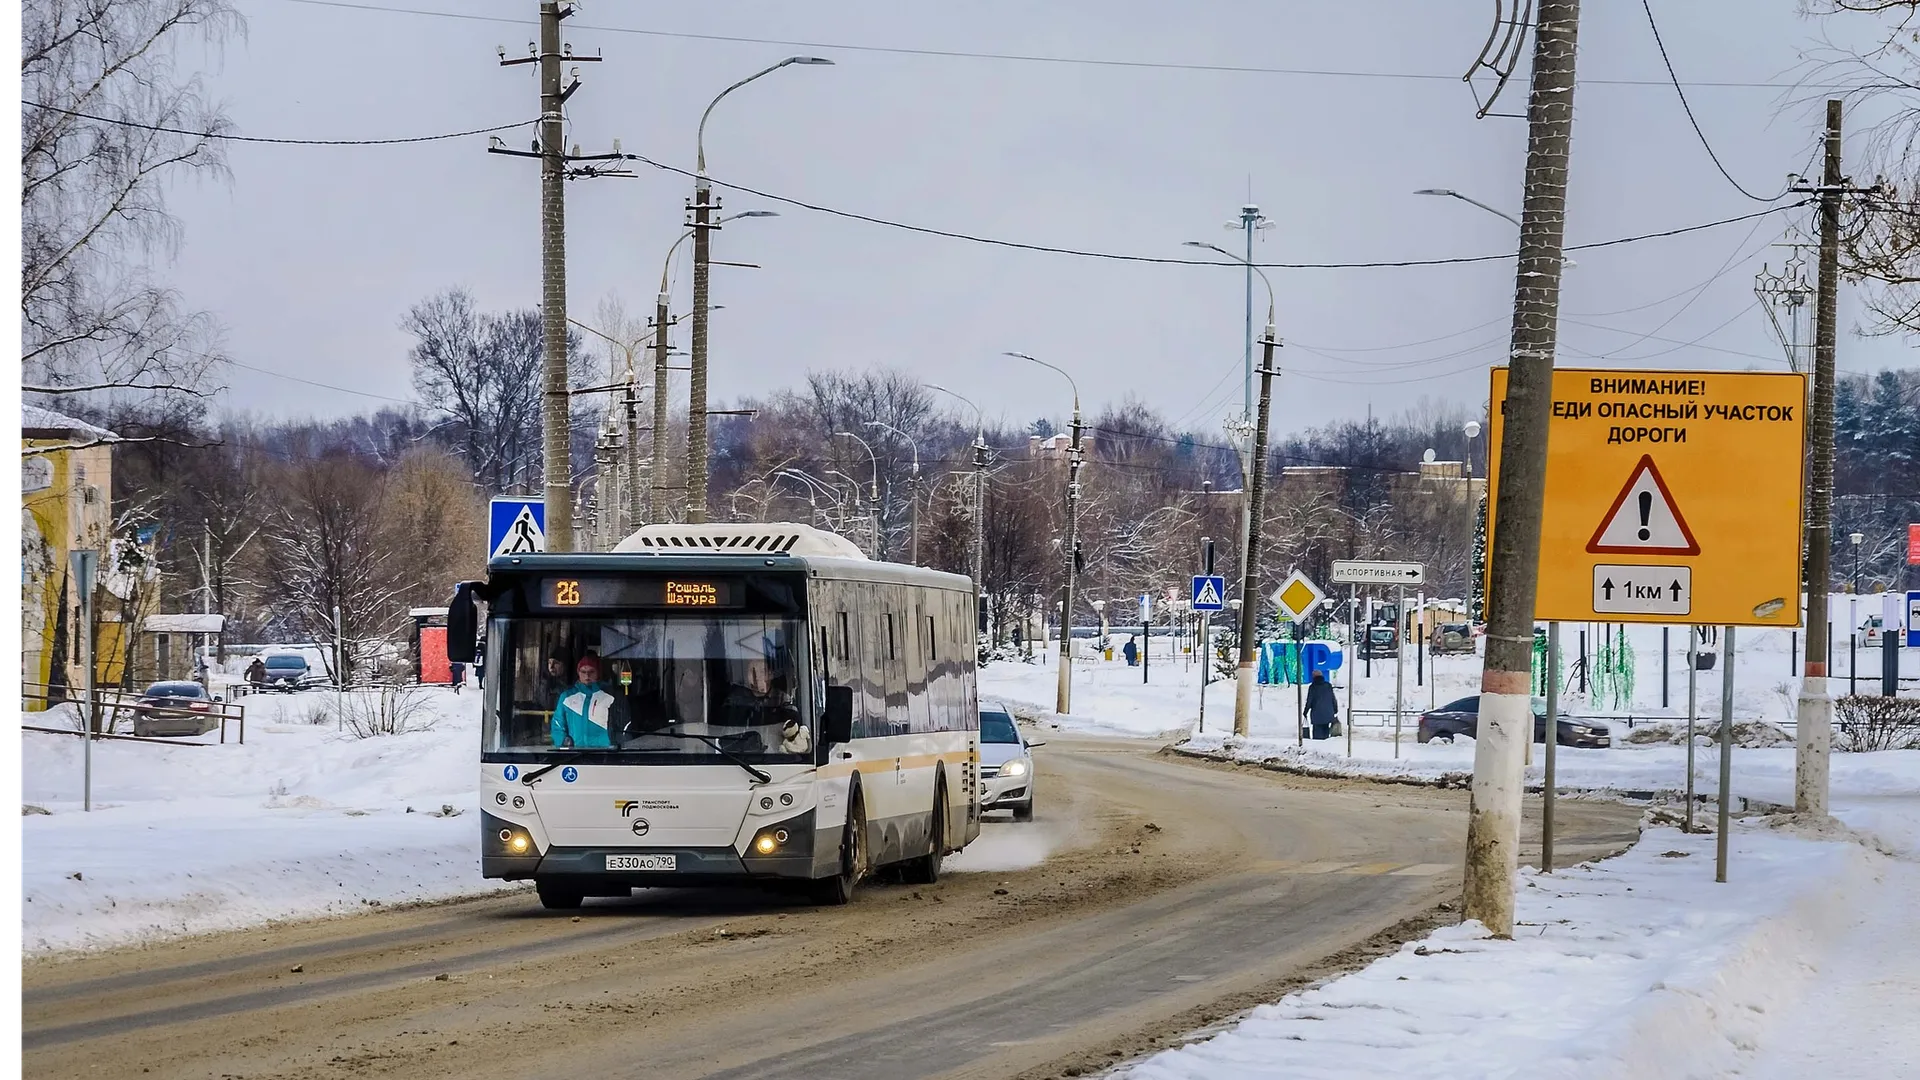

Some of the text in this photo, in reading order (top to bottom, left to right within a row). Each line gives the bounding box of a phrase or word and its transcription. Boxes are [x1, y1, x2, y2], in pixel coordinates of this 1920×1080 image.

[1590, 378, 1706, 395] ВНИМАНИЕ!
[1597, 400, 1698, 419] ОПАСНЫЙ
[1703, 404, 1794, 421] УЧАСТОК
[1607, 427, 1687, 445] ДОРОГИ
[1346, 568, 1403, 577] СПОРТИВНАЯ
[556, 581, 580, 605] 26
[667, 581, 716, 593] Рошаль
[667, 593, 716, 605] Шатура
[655, 856, 673, 866] 790
